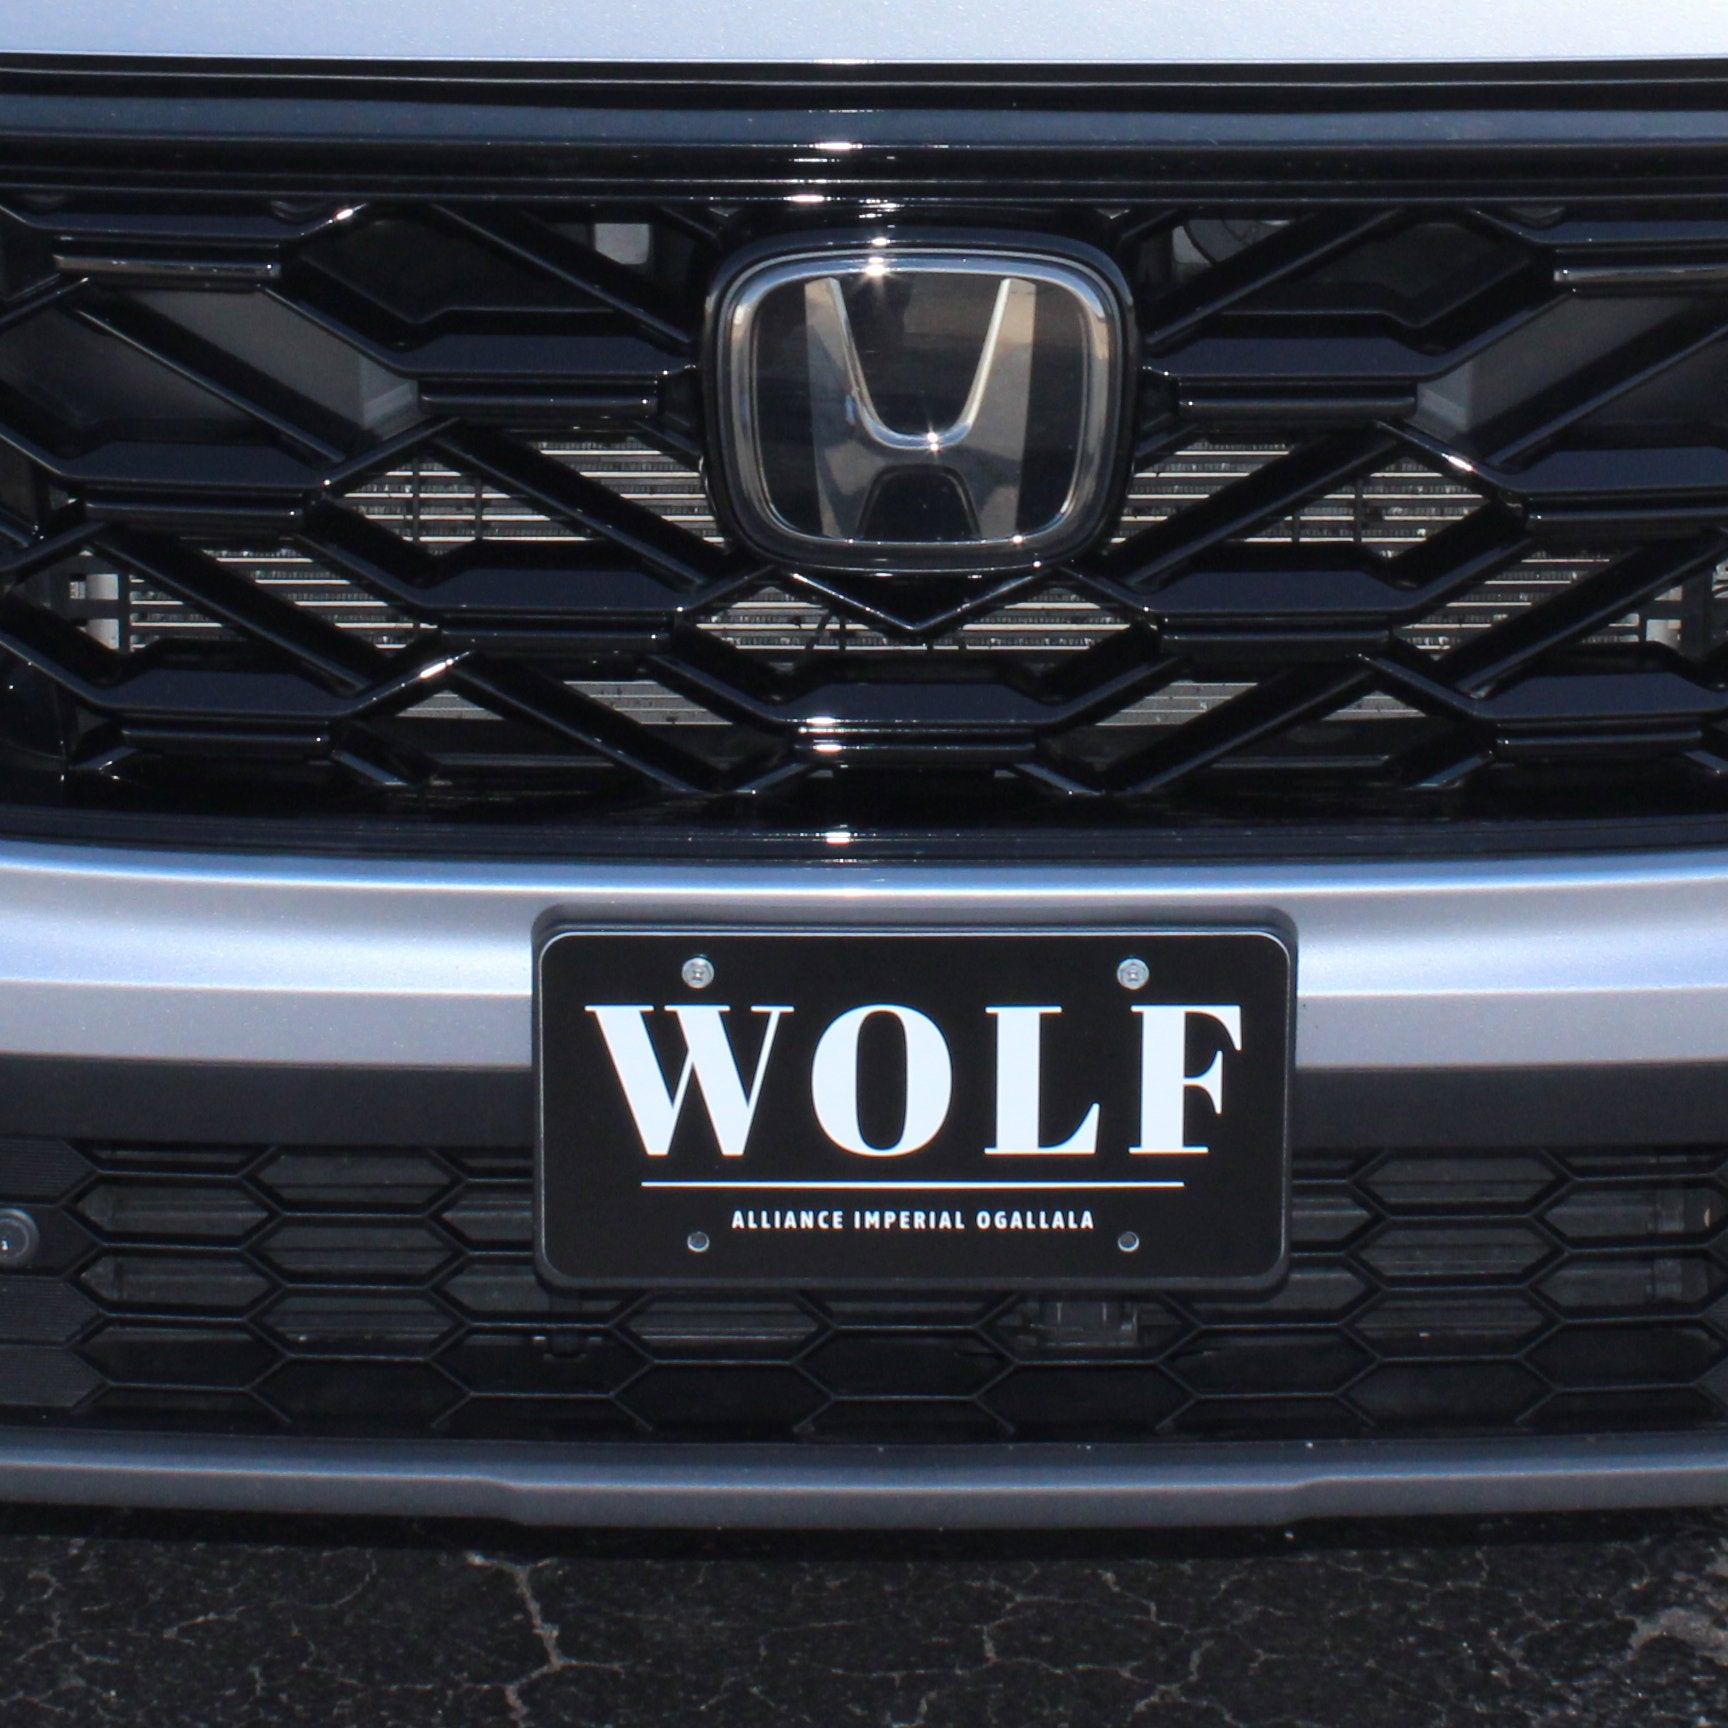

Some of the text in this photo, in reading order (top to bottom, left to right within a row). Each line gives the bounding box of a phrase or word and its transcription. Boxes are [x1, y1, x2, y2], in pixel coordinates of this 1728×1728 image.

[584, 1004, 1242, 1157] WOLF
[731, 1209, 1095, 1230] ALLIANCE IMPERIAL OGALLALA
